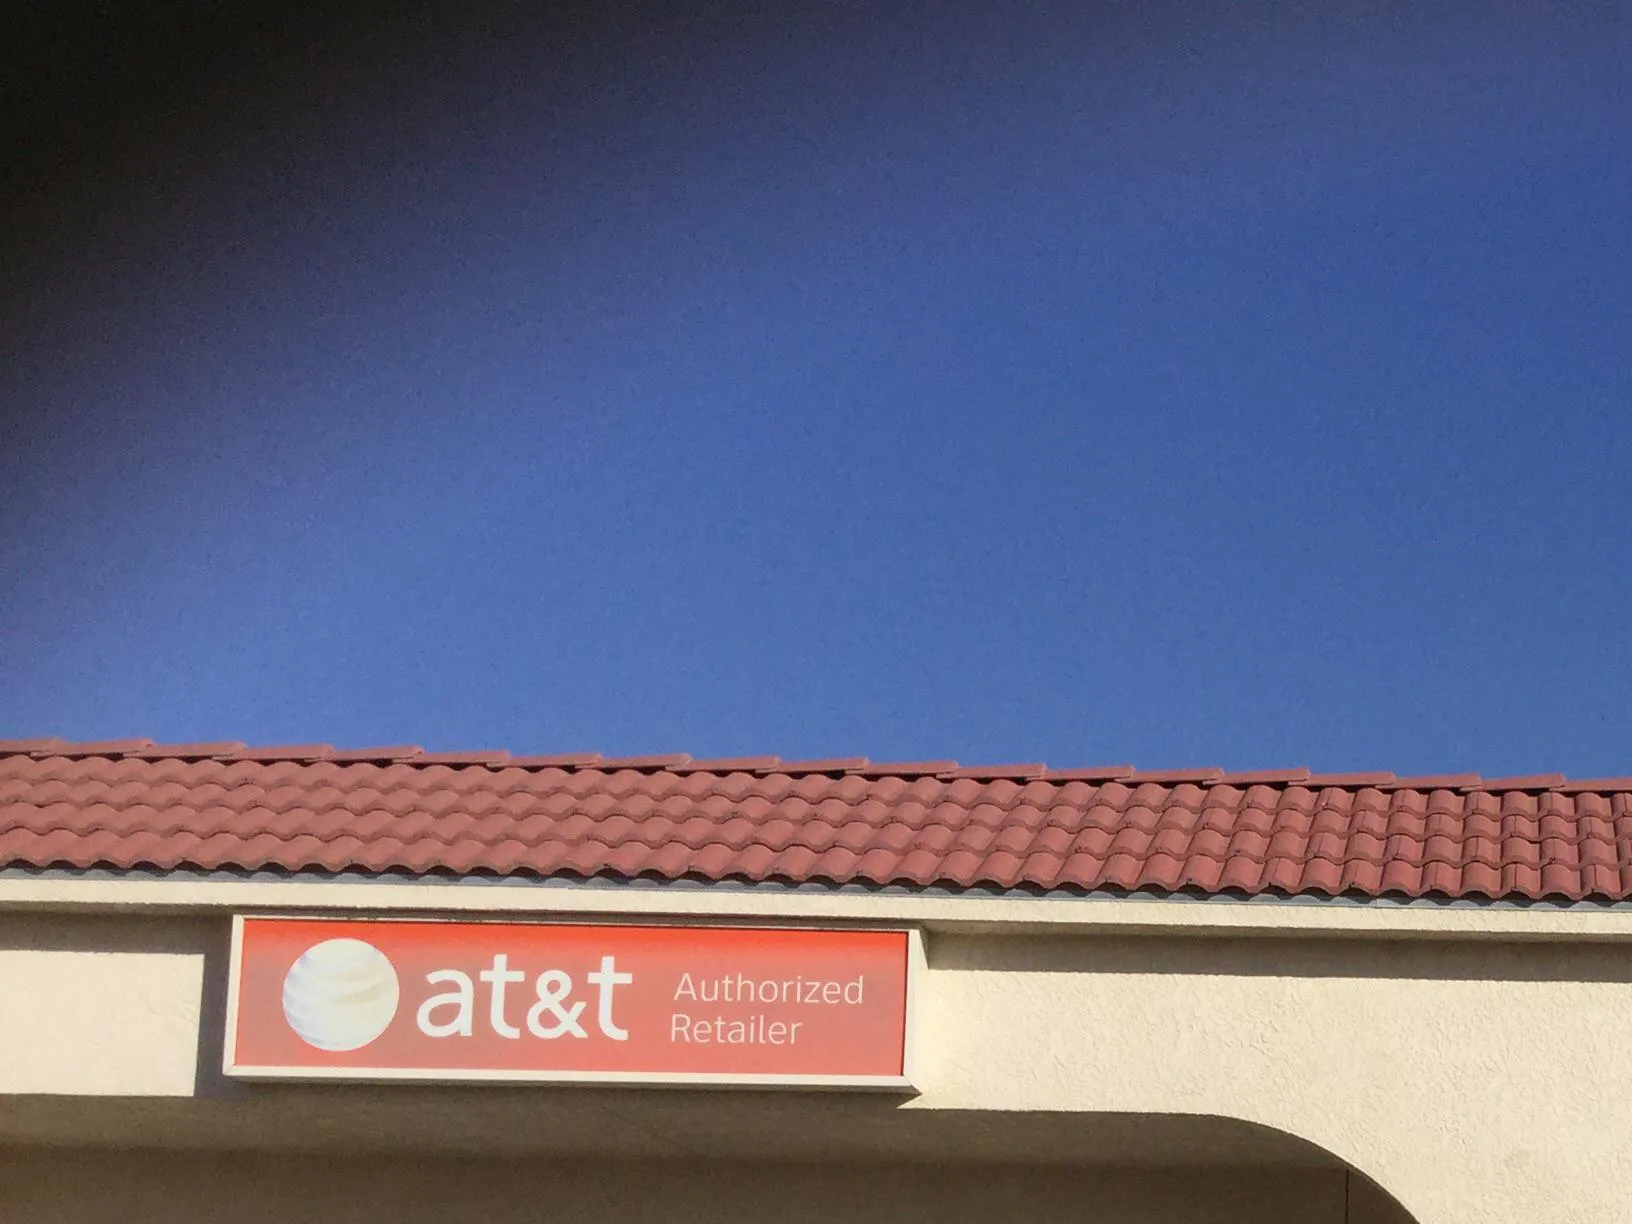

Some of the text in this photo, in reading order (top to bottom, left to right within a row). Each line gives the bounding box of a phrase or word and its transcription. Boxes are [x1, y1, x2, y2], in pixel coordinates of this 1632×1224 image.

[415, 953, 633, 1041] at&t
[672, 970, 864, 1006] Authorized
[670, 1012, 803, 1046] Retailer
